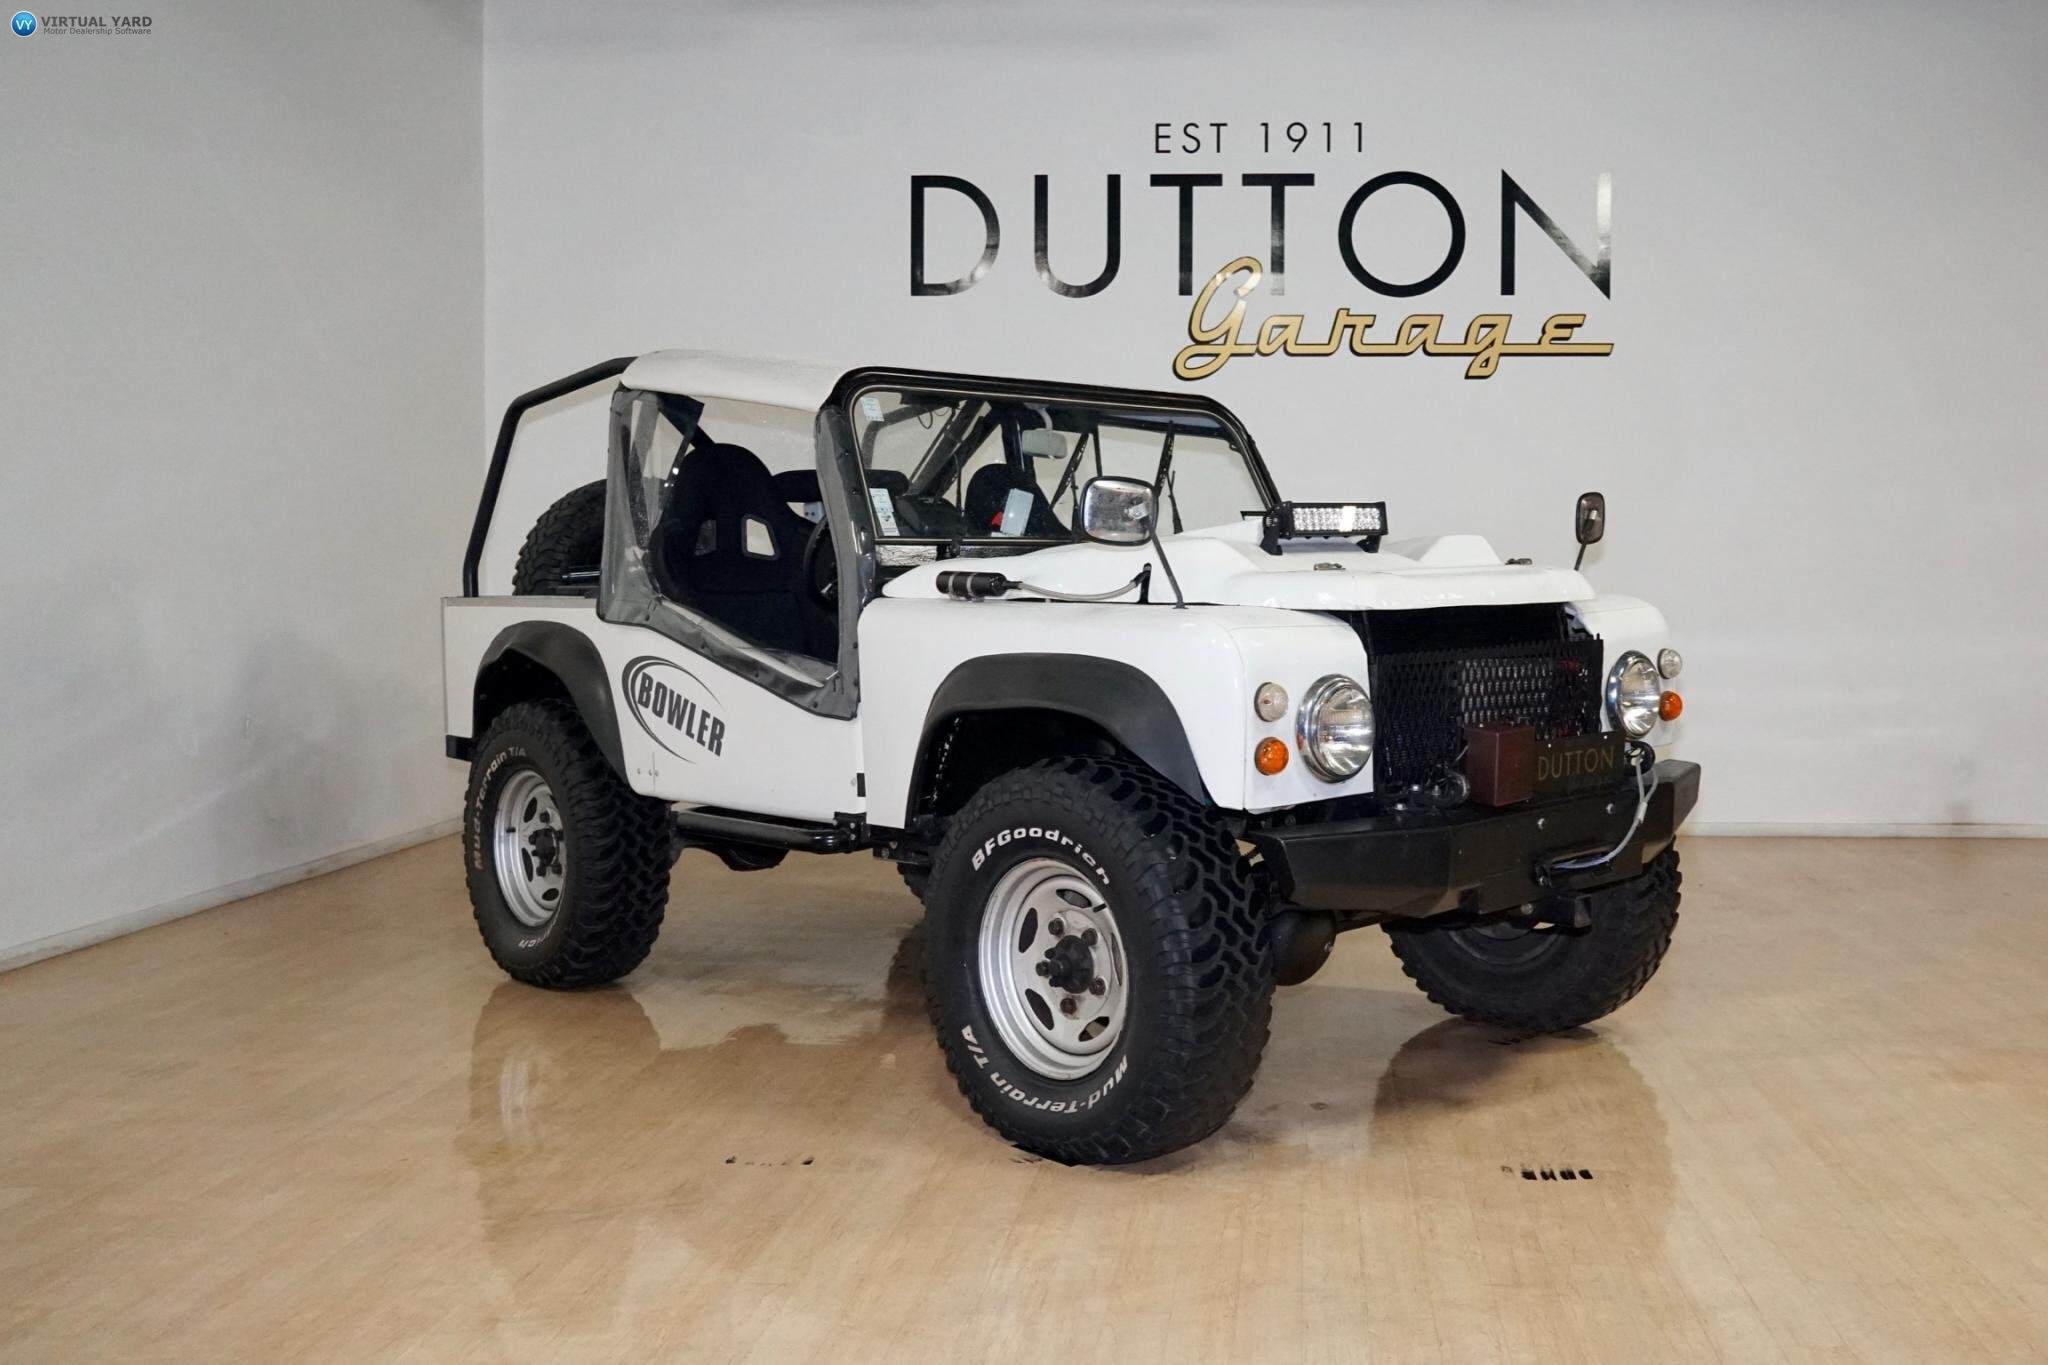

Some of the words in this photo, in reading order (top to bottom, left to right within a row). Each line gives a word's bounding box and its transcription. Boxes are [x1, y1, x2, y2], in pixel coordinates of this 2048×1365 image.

[1154, 122, 1228, 154] EST
[1259, 122, 1366, 154] 1911
[909, 168, 1613, 300] DUTTON
[1172, 255, 1616, 381] Garage
[637, 670, 726, 757] BOWLER
[1537, 745, 1615, 782] DUTTON
[971, 826, 1111, 886] BFGoodrich
[961, 1023, 990, 1070] T/A
[989, 1054, 1129, 1114] Mud-Terrain
